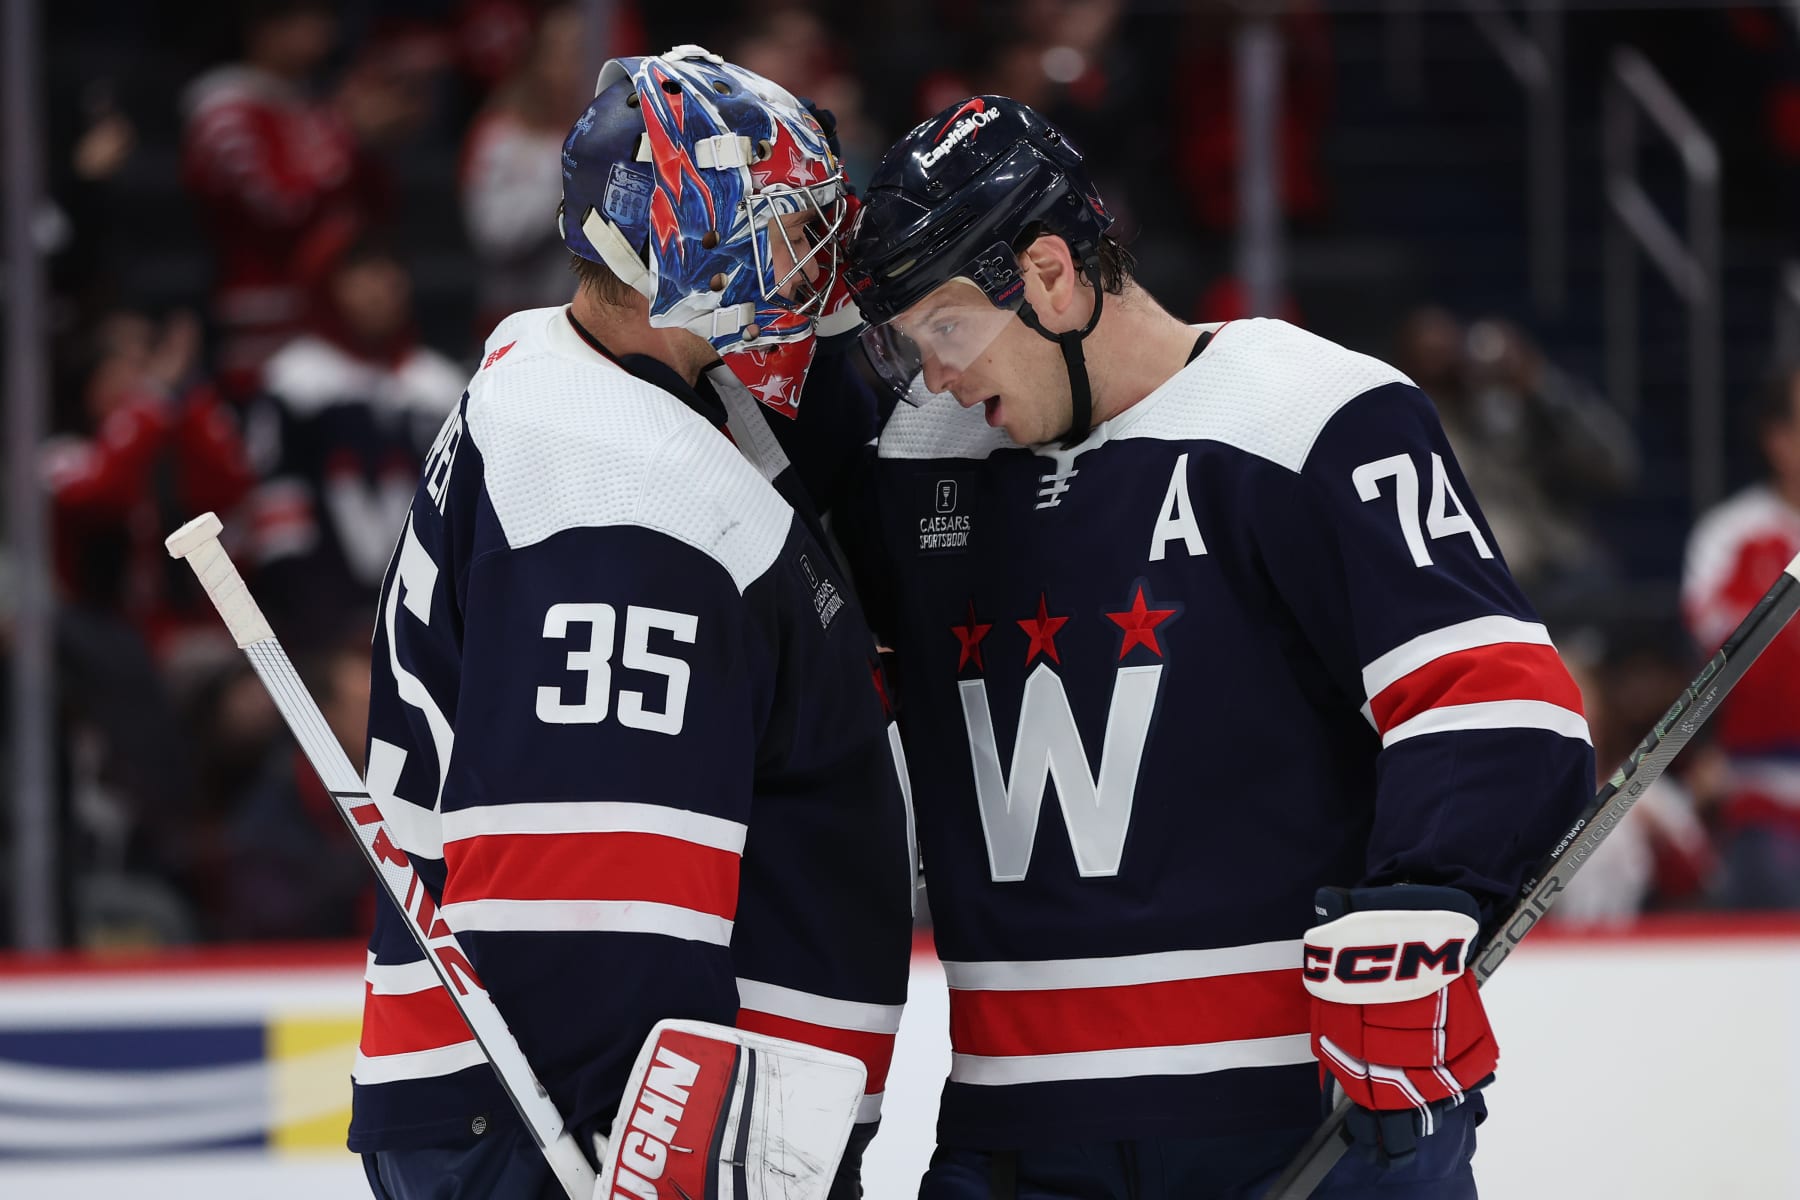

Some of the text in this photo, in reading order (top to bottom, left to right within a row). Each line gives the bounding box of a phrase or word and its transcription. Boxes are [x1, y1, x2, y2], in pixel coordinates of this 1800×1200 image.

[919, 532, 969, 549] SPORTSBOOK
[1149, 453, 1208, 561] A
[1352, 452, 1495, 568] 74
[535, 603, 699, 736] 35
[957, 661, 1164, 882] W
[1550, 818, 1586, 859] CARLSON
[1303, 938, 1466, 984] CCM
[1477, 875, 1566, 988] COR
